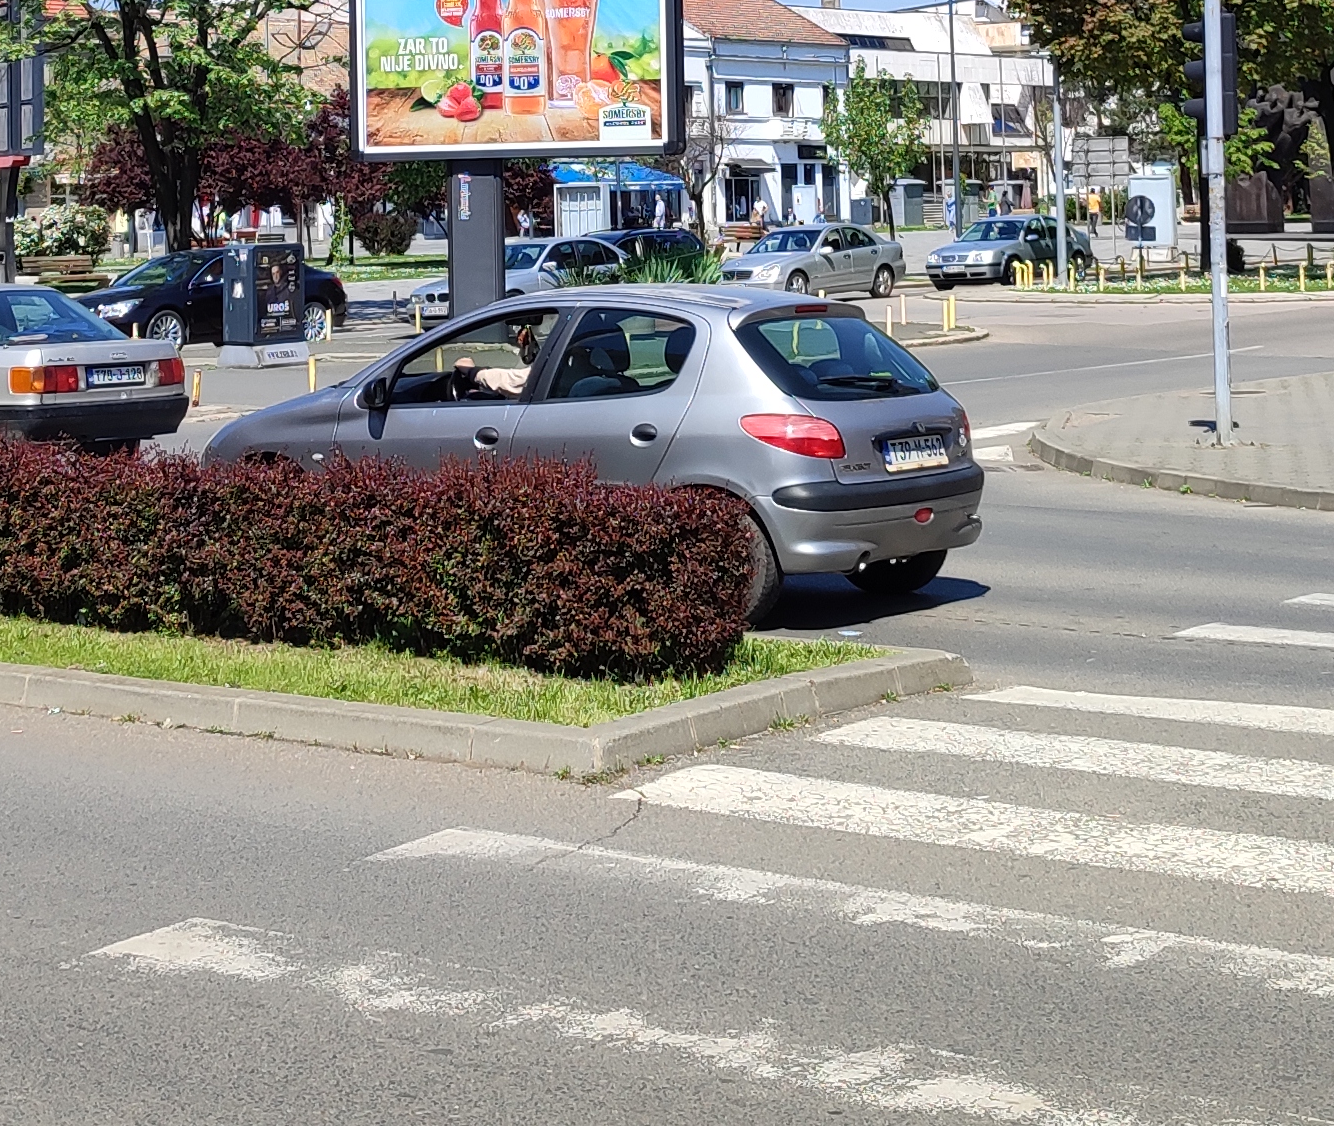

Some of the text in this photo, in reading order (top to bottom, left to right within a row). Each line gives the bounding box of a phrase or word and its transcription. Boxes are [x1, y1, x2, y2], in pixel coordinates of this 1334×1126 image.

[398, 37, 448, 55] ZAR TO
[380, 55, 412, 72] NIJE
[415, 53, 464, 71] DIVNO.
[602, 108, 646, 120] SOMERSBY
[267, 301, 289, 313] UROŠ
